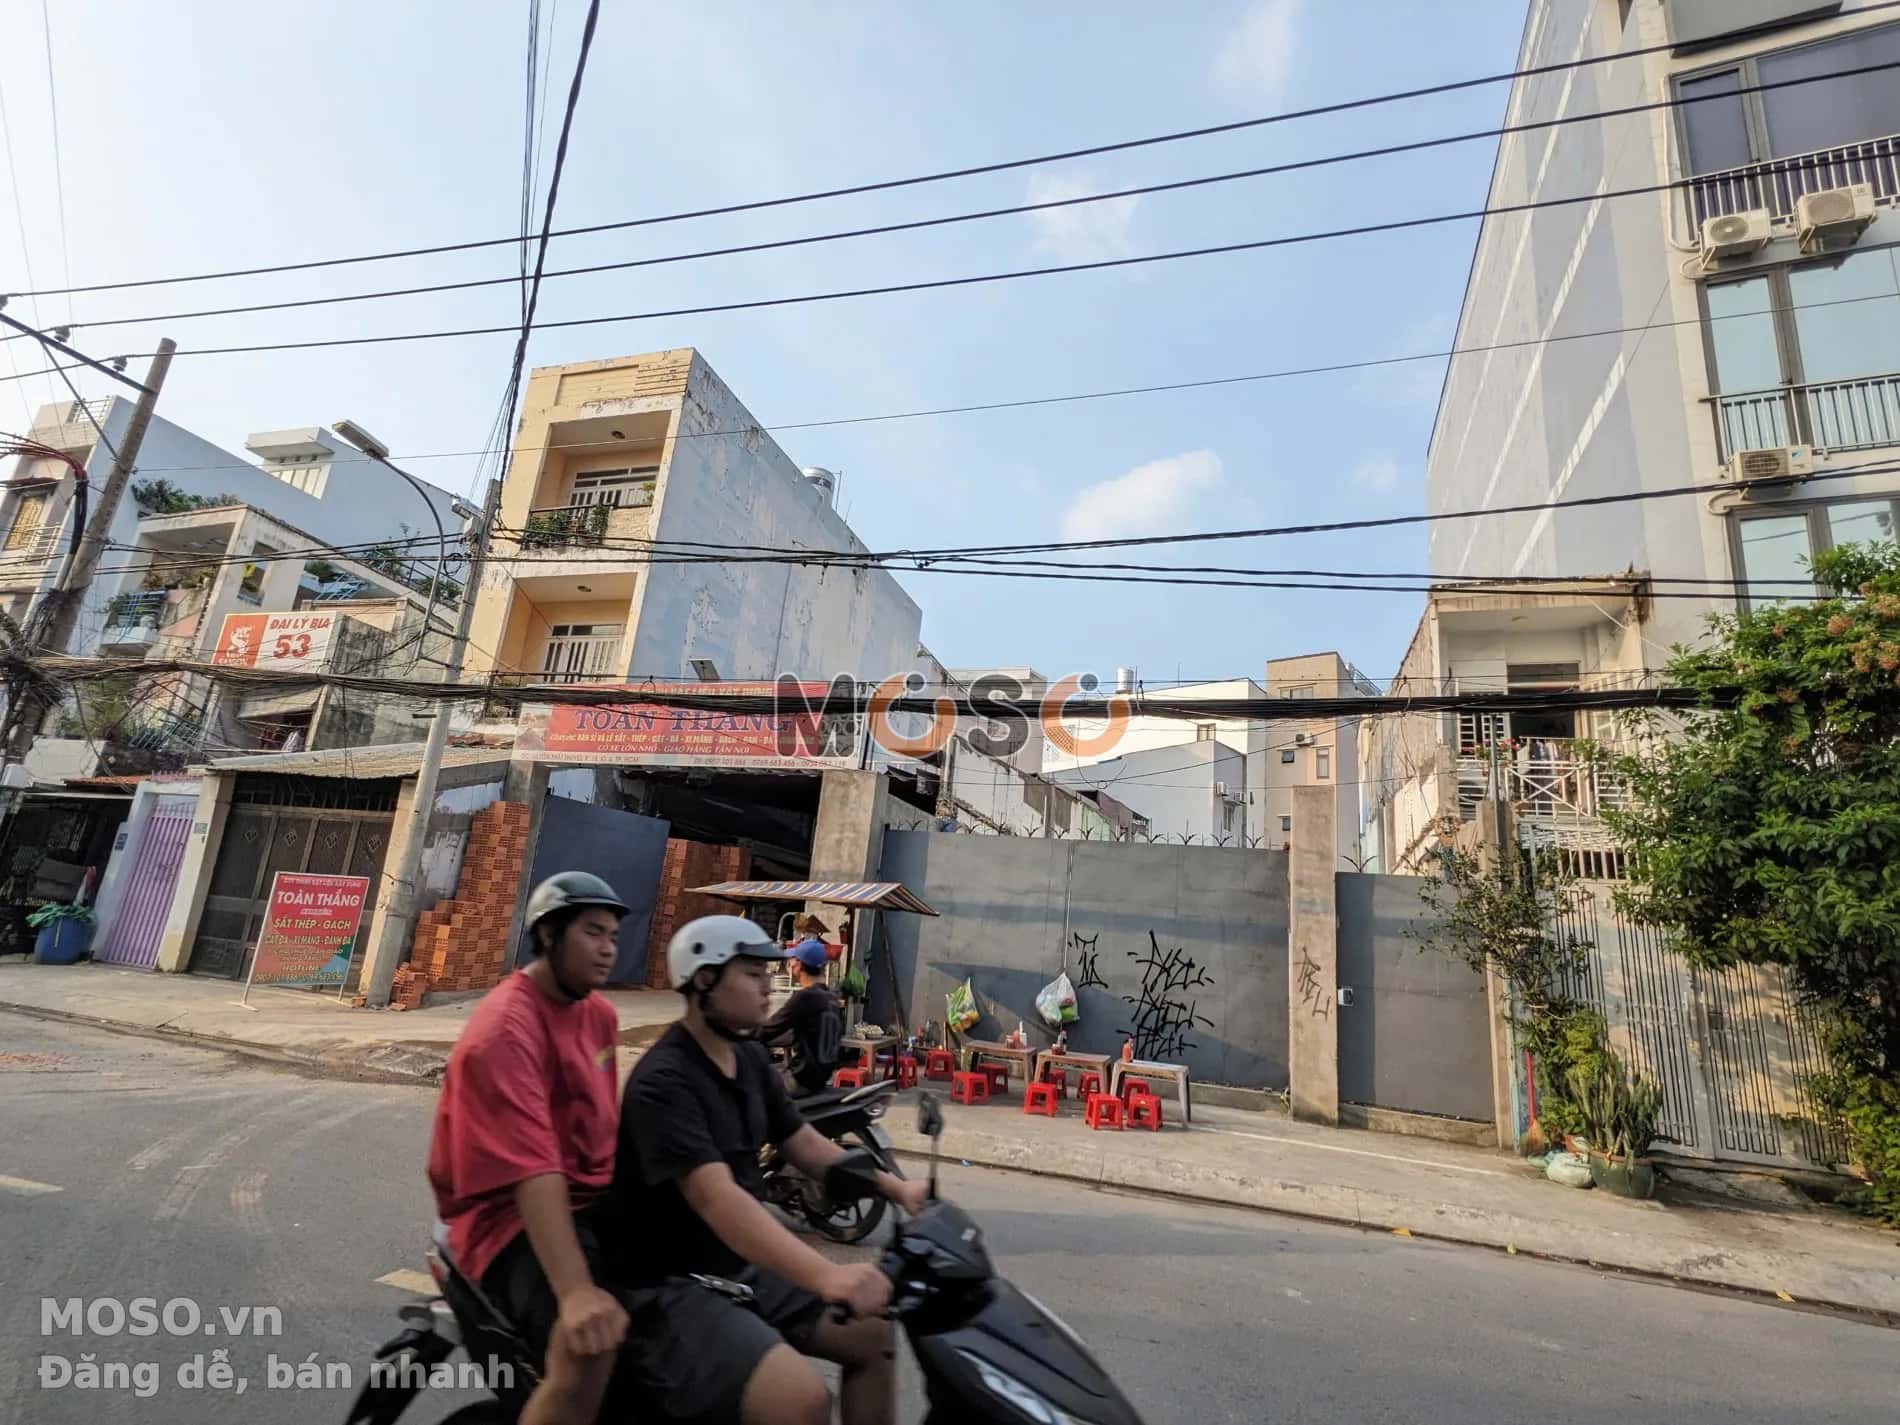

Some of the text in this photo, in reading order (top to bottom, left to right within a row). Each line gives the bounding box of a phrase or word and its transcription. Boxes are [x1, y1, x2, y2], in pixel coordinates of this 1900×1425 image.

[273, 633, 312, 659] 53
[575, 704, 657, 730] TOÀN
[277, 888, 361, 907] TOÀN THẮNG
